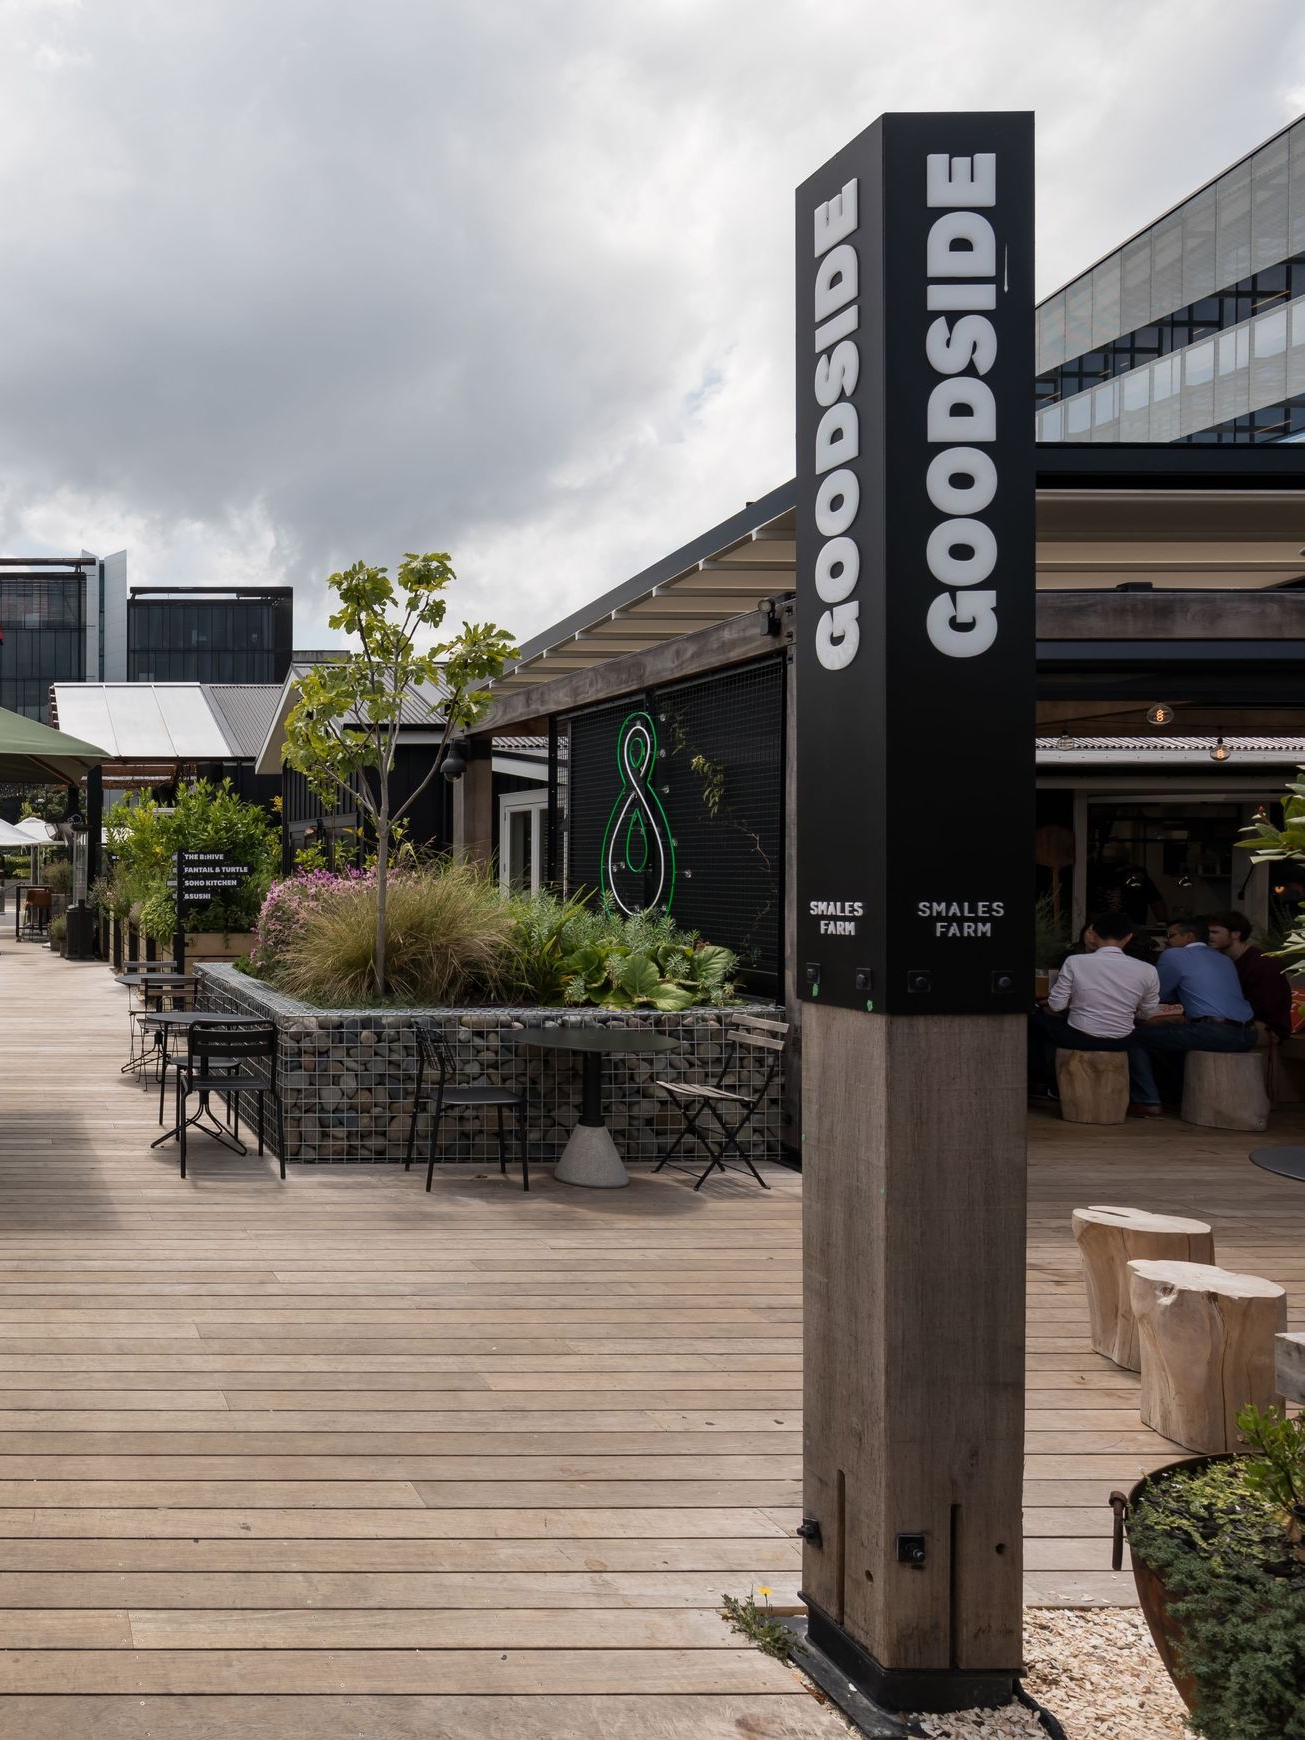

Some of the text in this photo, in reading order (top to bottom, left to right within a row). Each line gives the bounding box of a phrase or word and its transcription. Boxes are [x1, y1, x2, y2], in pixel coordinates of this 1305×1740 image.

[925, 152, 998, 658] GOODSIDE
[813, 177, 860, 671] GOODSIDE
[809, 901, 864, 917] SMALES
[917, 901, 1005, 917] SMALES
[820, 920, 856, 936] FARM
[935, 922, 992, 937] FARM
